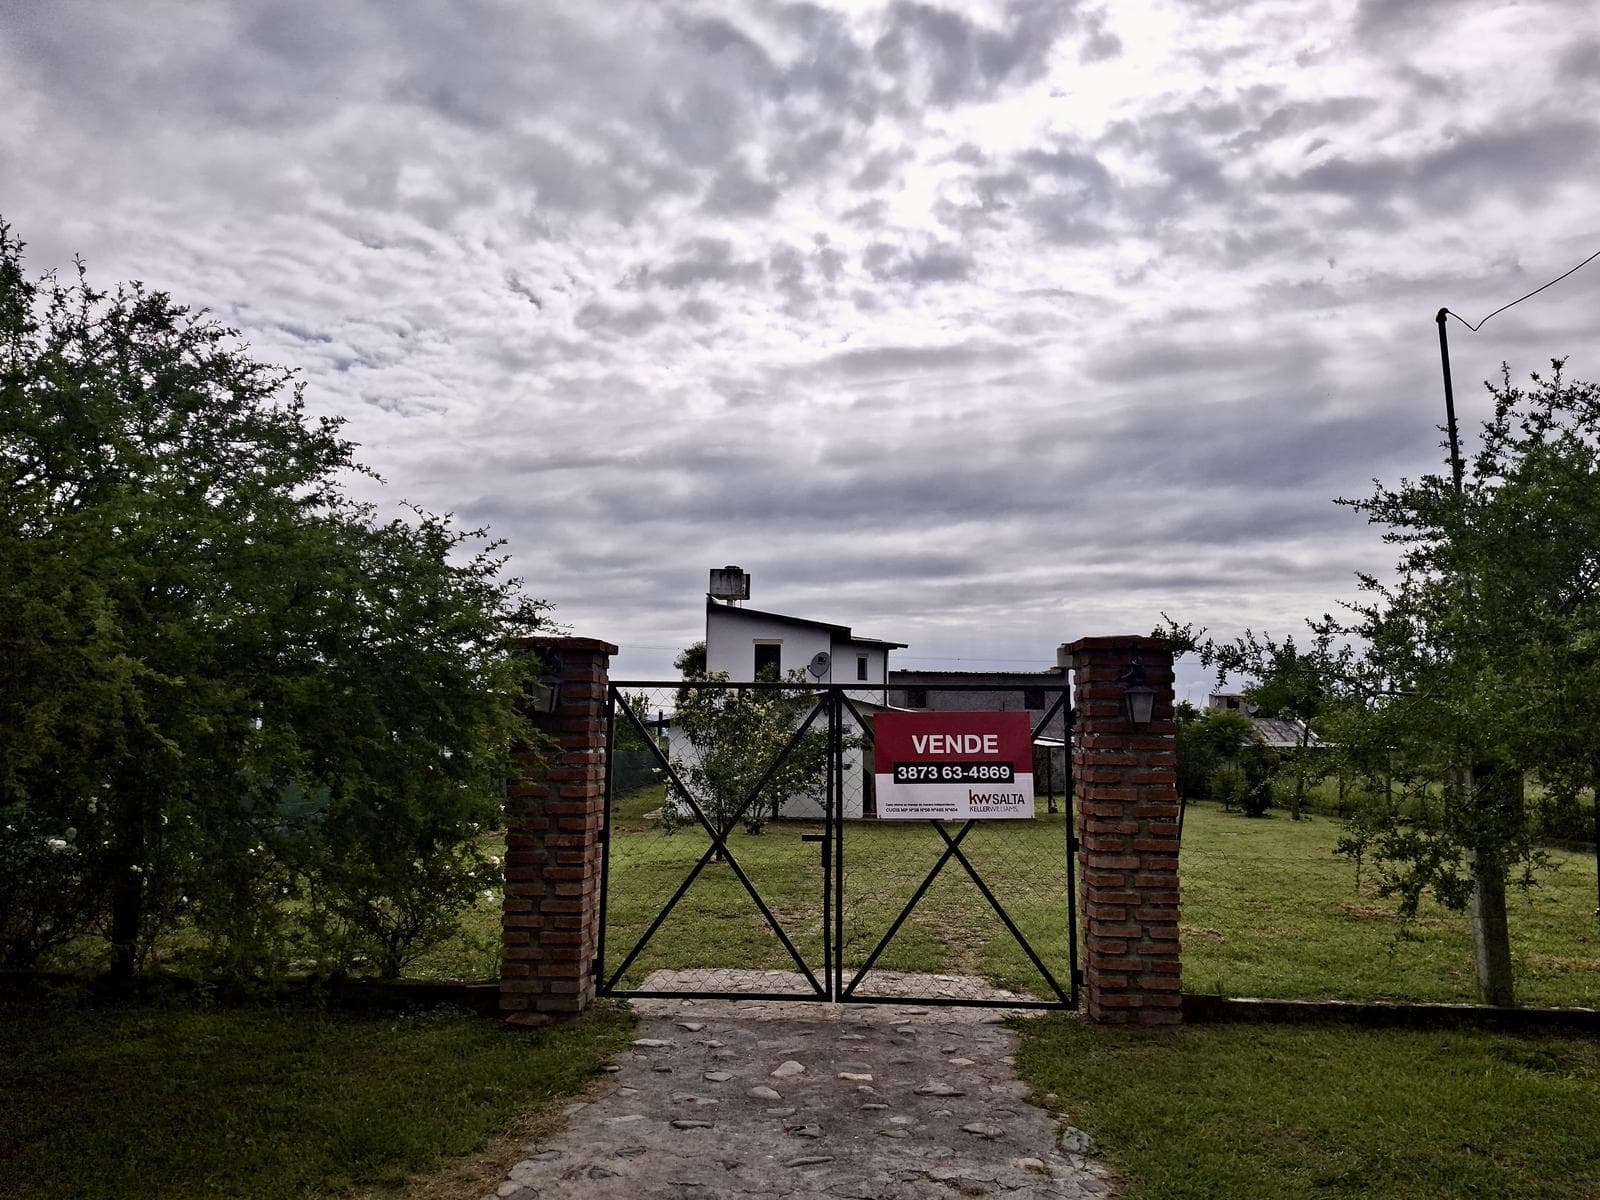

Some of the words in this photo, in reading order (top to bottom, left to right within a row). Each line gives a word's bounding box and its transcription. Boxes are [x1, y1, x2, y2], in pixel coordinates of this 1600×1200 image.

[912, 734, 999, 754] VENDE
[897, 766, 938, 779] 3873
[942, 766, 1010, 779] 63-4869
